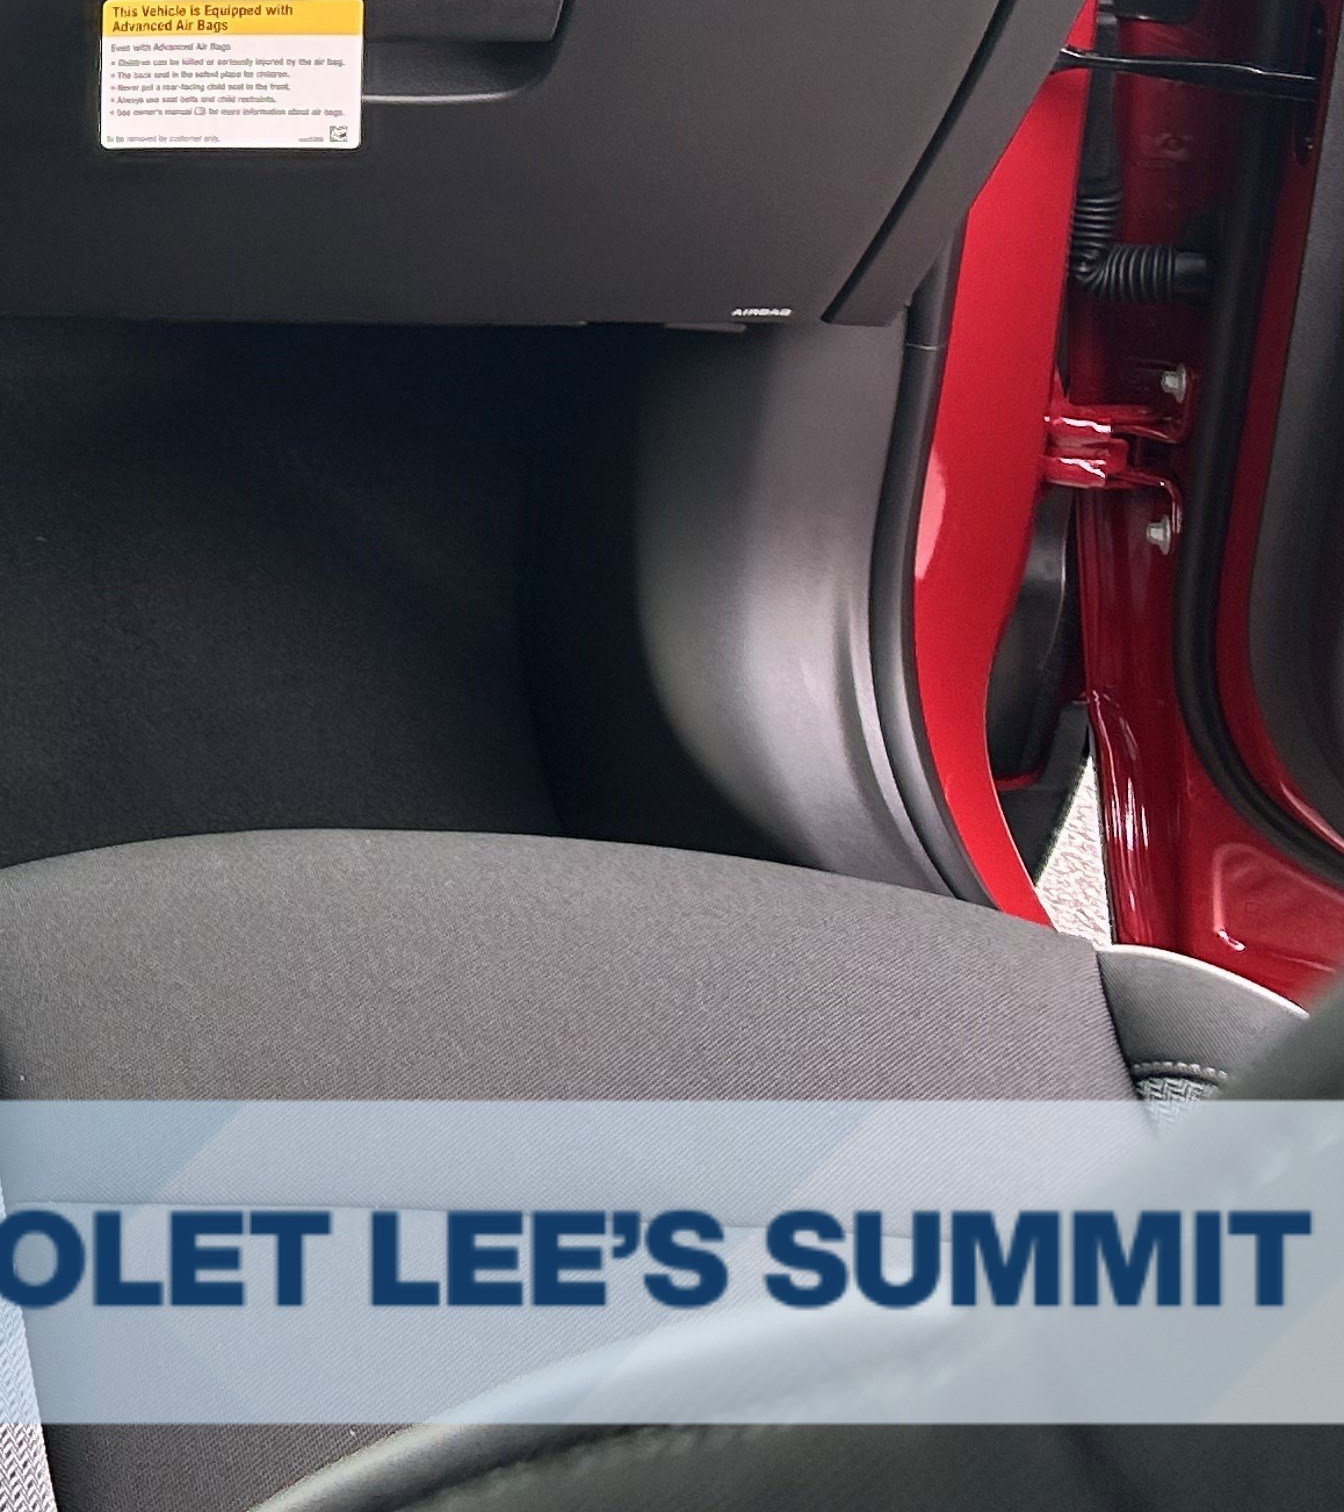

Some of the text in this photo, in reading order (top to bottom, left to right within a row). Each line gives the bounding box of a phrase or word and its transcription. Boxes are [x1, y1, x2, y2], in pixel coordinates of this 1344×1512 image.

[113, 4, 293, 18] This Vehicle is Equipped with
[112, 19, 228, 33] Advanced Air Bags
[731, 308, 792, 316] AIRBAG
